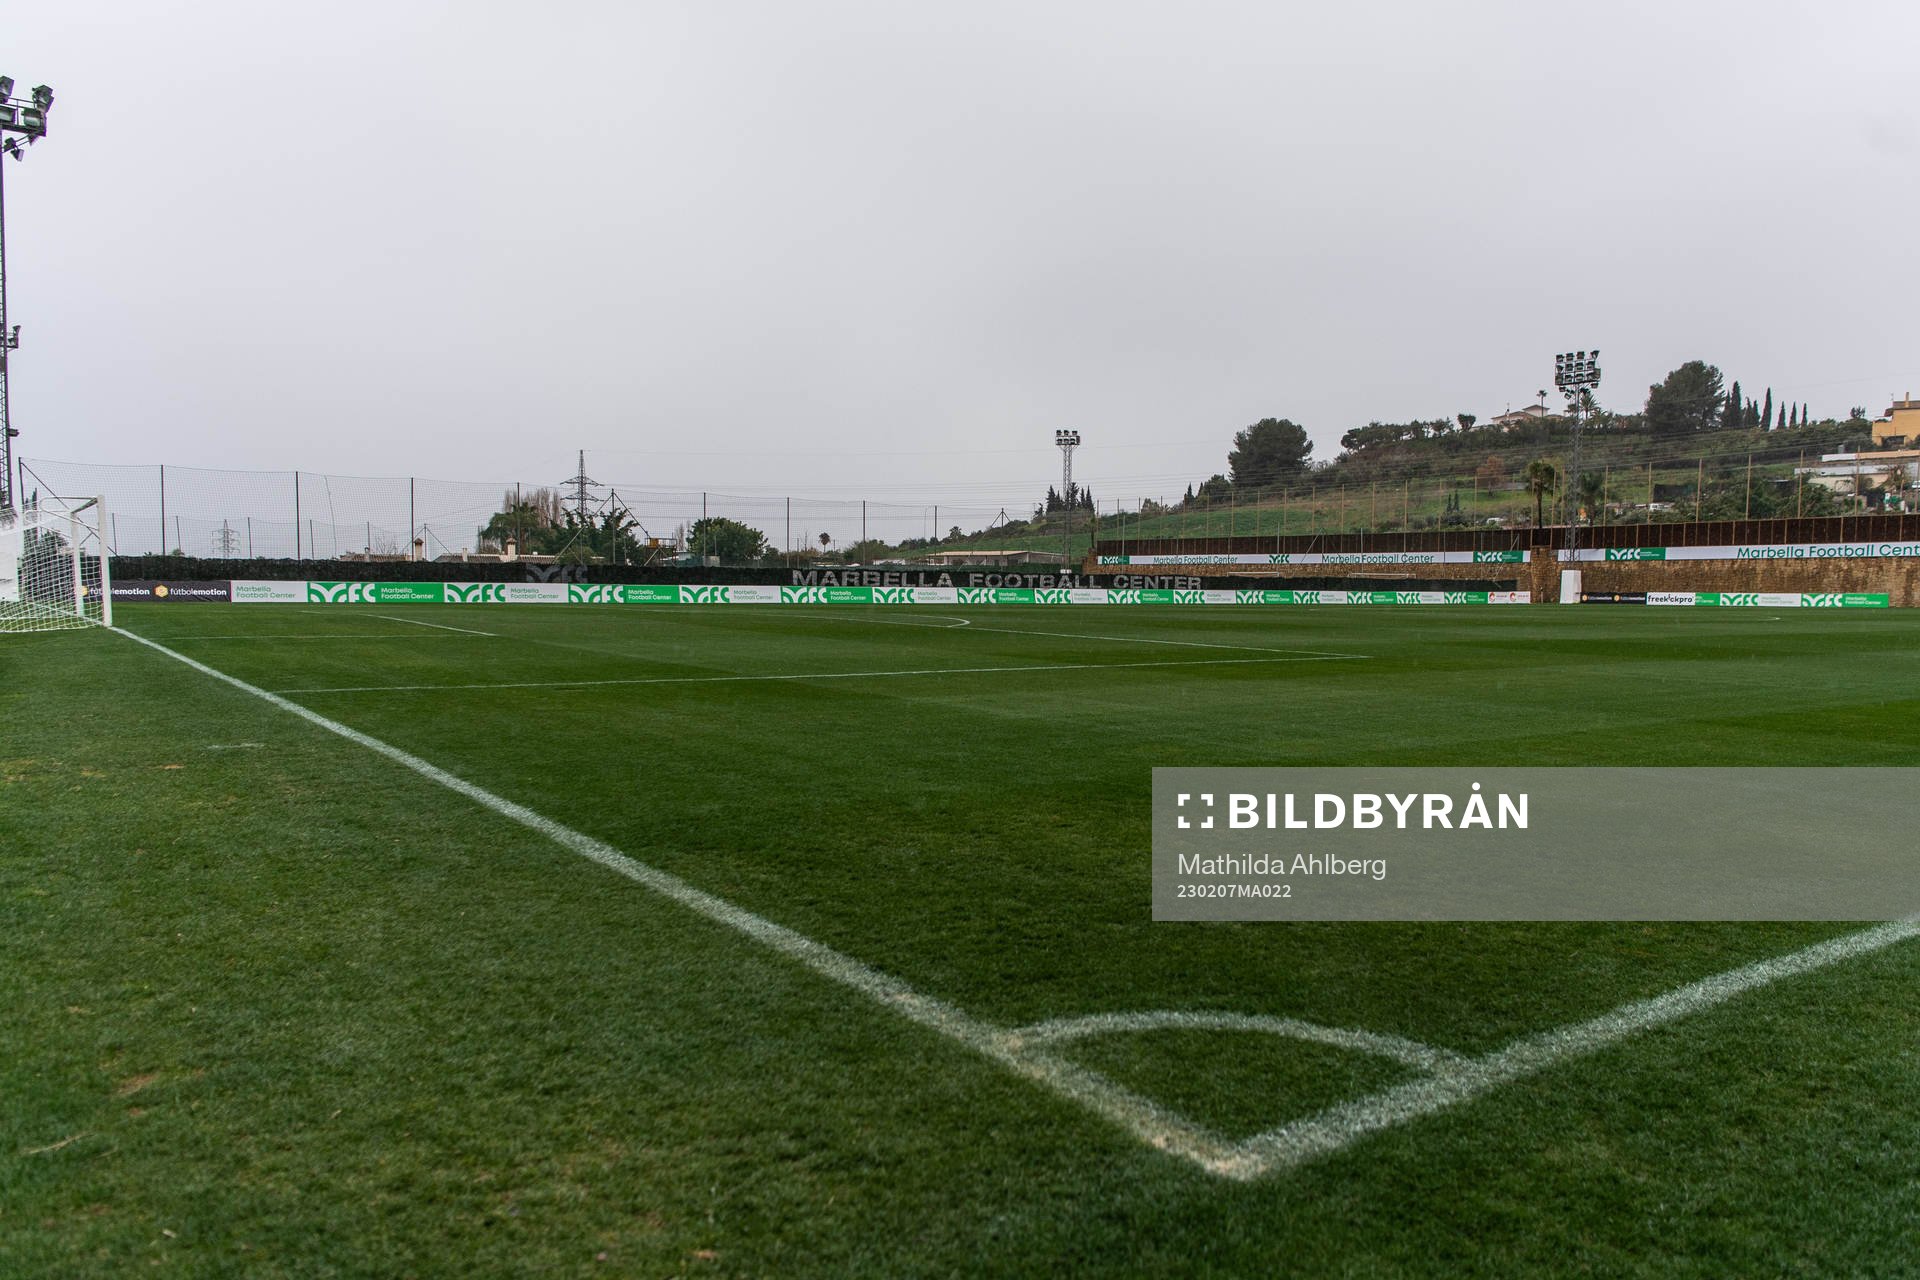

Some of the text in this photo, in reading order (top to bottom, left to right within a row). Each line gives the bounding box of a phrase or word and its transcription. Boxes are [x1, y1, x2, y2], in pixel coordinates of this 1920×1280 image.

[1738, 546, 1804, 559] Marbella
[1809, 544, 1874, 558] Football
[1153, 556, 1238, 564] Marbella Football Center
[1322, 554, 1434, 563] Marbella Football Center
[792, 570, 1201, 590] MARBELLA FOOTBALL CENTER
[170, 588, 227, 596] fútbolemotion
